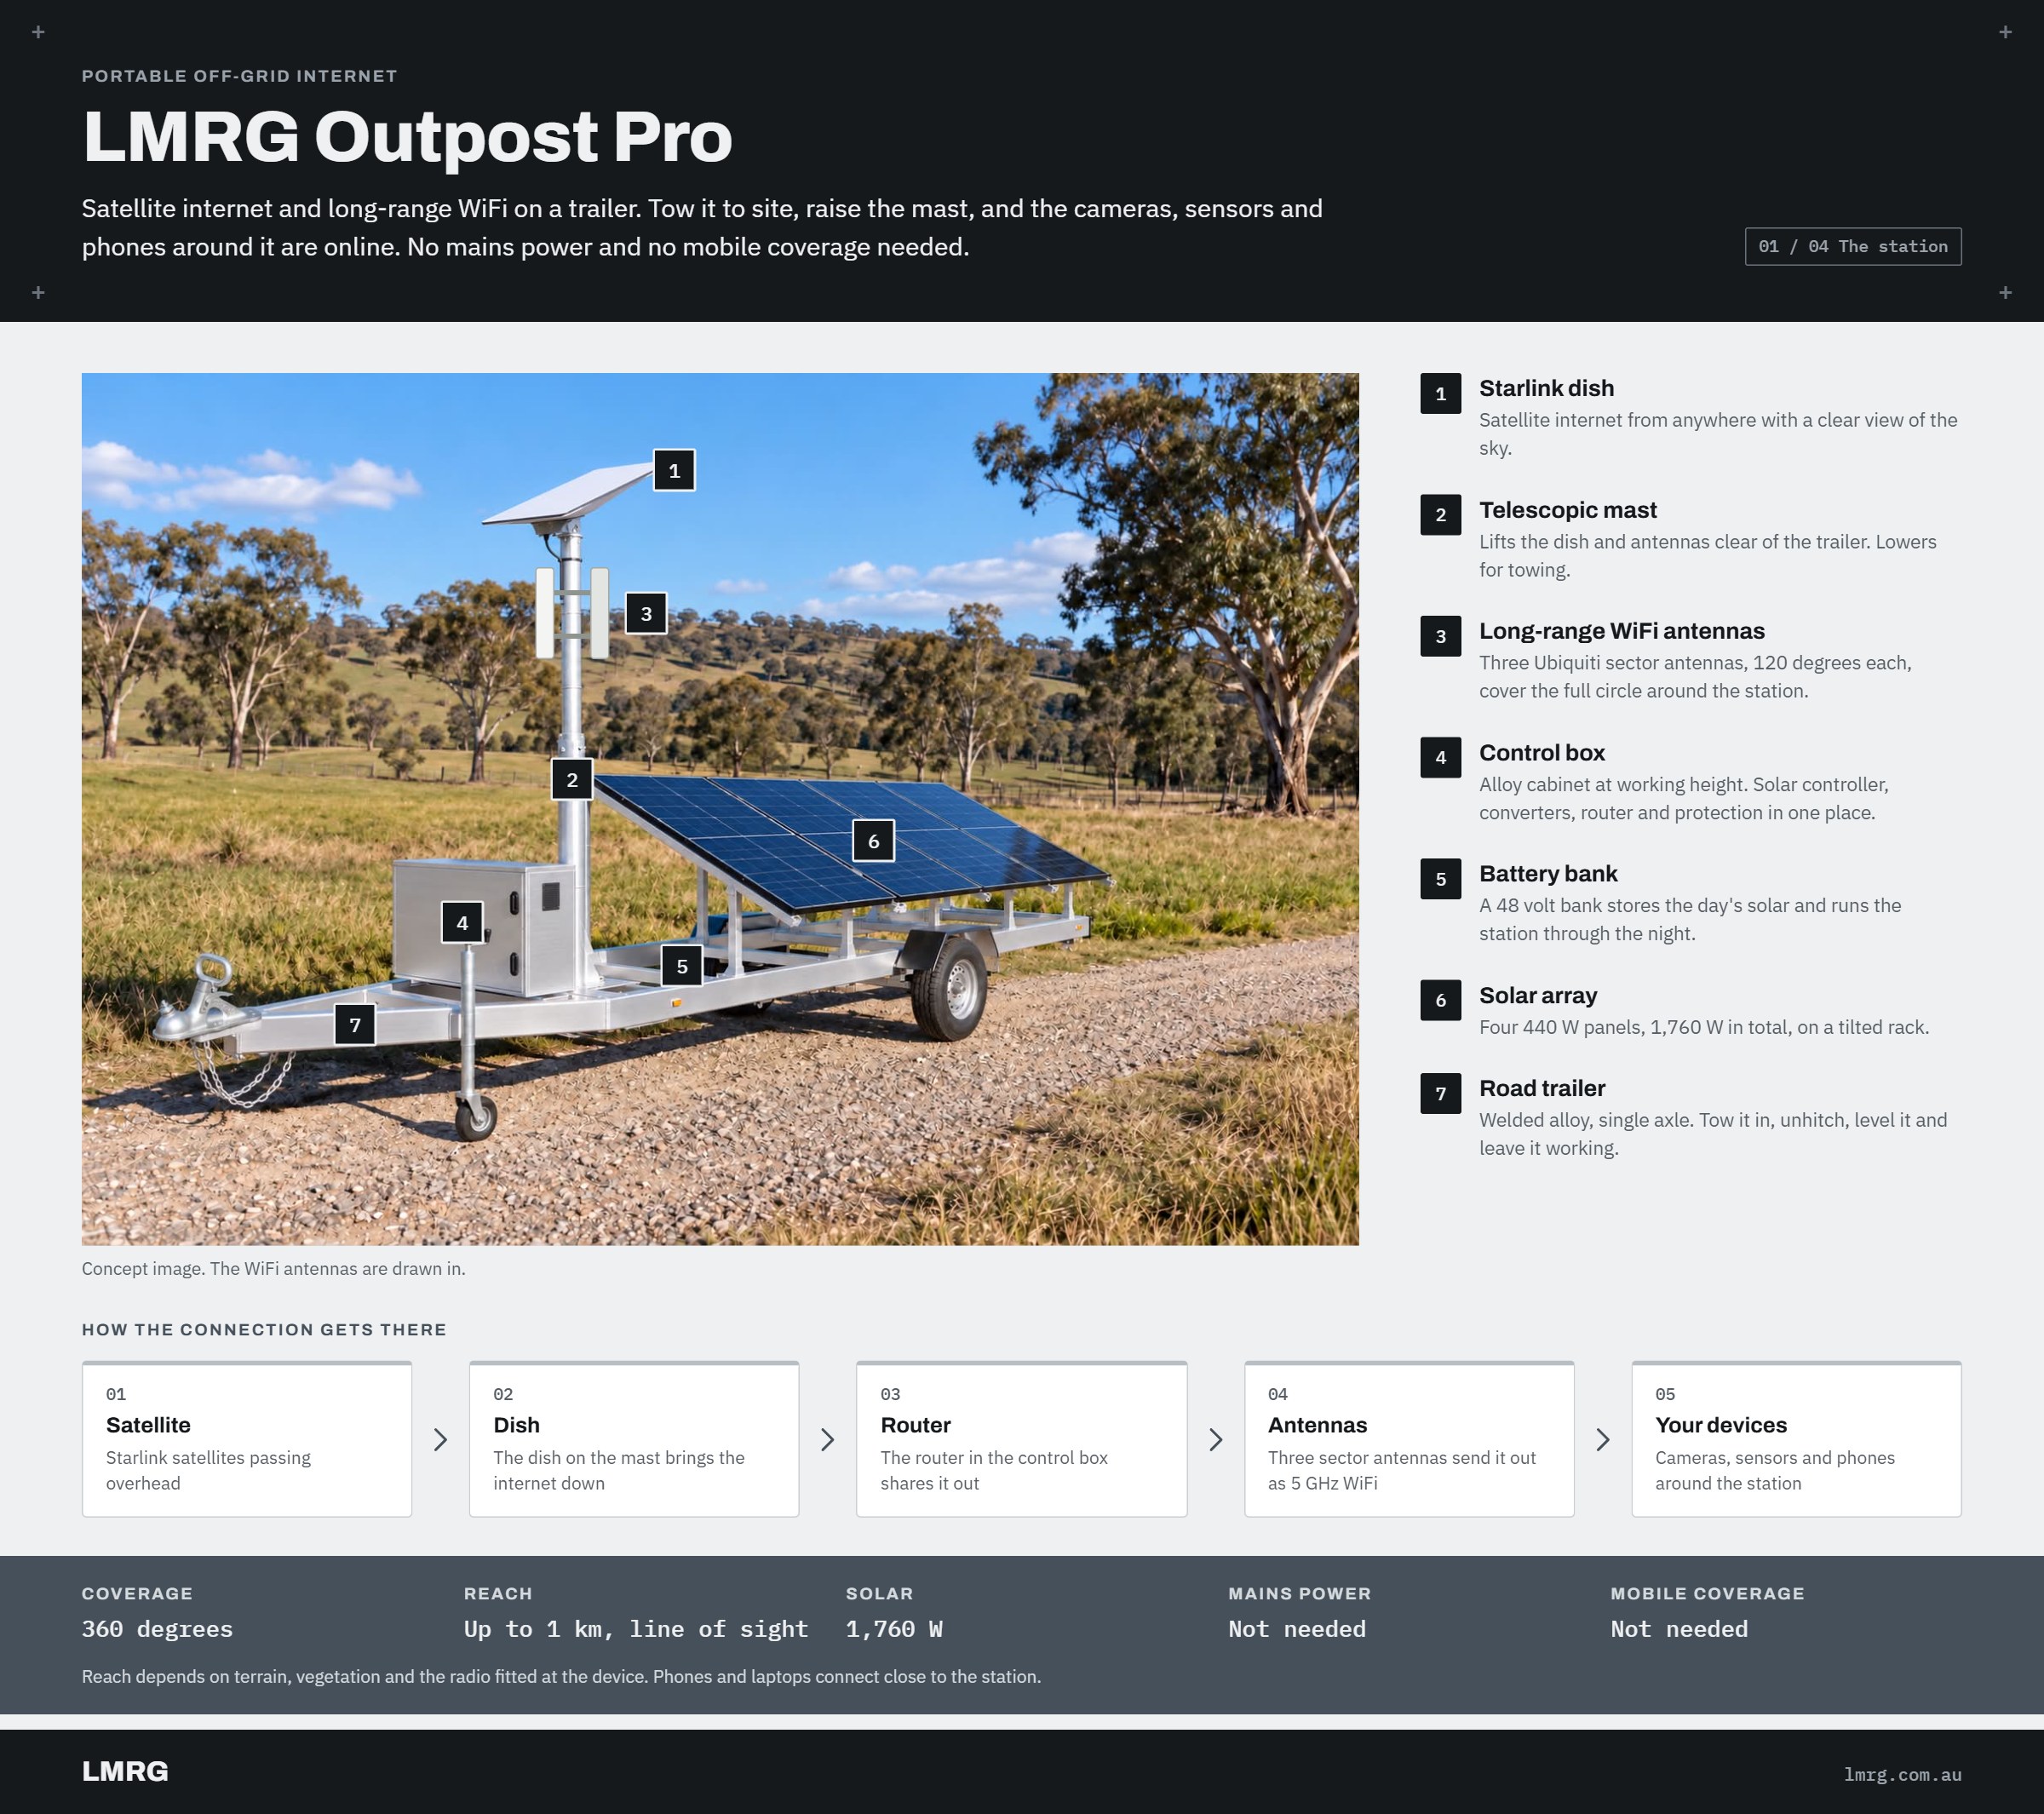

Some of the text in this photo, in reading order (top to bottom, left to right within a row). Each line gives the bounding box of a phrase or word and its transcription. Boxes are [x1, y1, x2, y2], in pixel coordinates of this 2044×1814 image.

[82, 69, 398, 83] PORTABLE OFF-GRID INTERNET
[86, 110, 732, 175] LMRG Outpost Pro
[83, 236, 969, 261] phones around it are online. No mains power and no mobile coverage needed.
[1759, 238, 1949, 255] 01 / 04 The station
[1435, 387, 1447, 401] 1
[1479, 378, 1615, 398] Starlink dish
[1479, 439, 1513, 460] sky.
[1435, 508, 1447, 522] 2
[1478, 500, 1658, 523] Telescopic mast
[1478, 561, 1570, 582] for towing.
[1435, 629, 1447, 644] 3
[1480, 621, 1766, 644] Long-range WiFi antennas
[1478, 654, 1912, 675] Three Ubiquiti sector antennas, 120 degrees each,
[1435, 750, 1448, 765] 4
[1479, 743, 1606, 762] Control box
[1436, 872, 1447, 887] 5
[1480, 864, 1619, 887] Battery bank
[1479, 925, 1696, 945] station through the night.
[1435, 993, 1447, 1007] 6
[1479, 985, 1599, 1008] Solar array
[1435, 1087, 1447, 1101] 7
[1480, 1078, 1607, 1098] Road trailer
[1480, 1139, 1619, 1160] leave it working.
[82, 1323, 446, 1336] HOW THE CONNECTION GETS THERE
[106, 1387, 127, 1401] 01
[493, 1387, 514, 1401] 02
[881, 1387, 901, 1401] 03
[1268, 1387, 1289, 1401] 04
[1655, 1387, 1676, 1401] 05
[106, 1415, 192, 1434] Satellite
[494, 1415, 540, 1434] Dish
[881, 1416, 952, 1434] Router
[1267, 1416, 1368, 1434] Antennas
[1655, 1415, 1788, 1434] Your devices
[106, 1449, 312, 1468] Starlink satellites passing
[106, 1475, 181, 1490] overhead
[1268, 1475, 1378, 1490] as 5 GHz WiFi
[1656, 1475, 1802, 1490] around the station
[81, 1587, 192, 1600] COVERAGE
[464, 1587, 531, 1600] REACH
[846, 1587, 913, 1600] SOLAR
[1228, 1587, 1371, 1600] MAINS POWER
[1611, 1587, 1805, 1601] MOBILE COVERAGE
[82, 1619, 233, 1642] 360 degrees
[464, 1619, 808, 1642] Up to 1 km, line of sight
[846, 1620, 944, 1641] 1,760 W
[1229, 1619, 1366, 1638] Not needed
[1611, 1619, 1748, 1638] Not needed
[82, 1668, 1042, 1687] Reach depends on terrain, vegetation and the radio fitted at the device. Phones and laptops connect close to the station.
[83, 1760, 169, 1782] LMRG
[1845, 1766, 1962, 1785] lmrg.com.au
